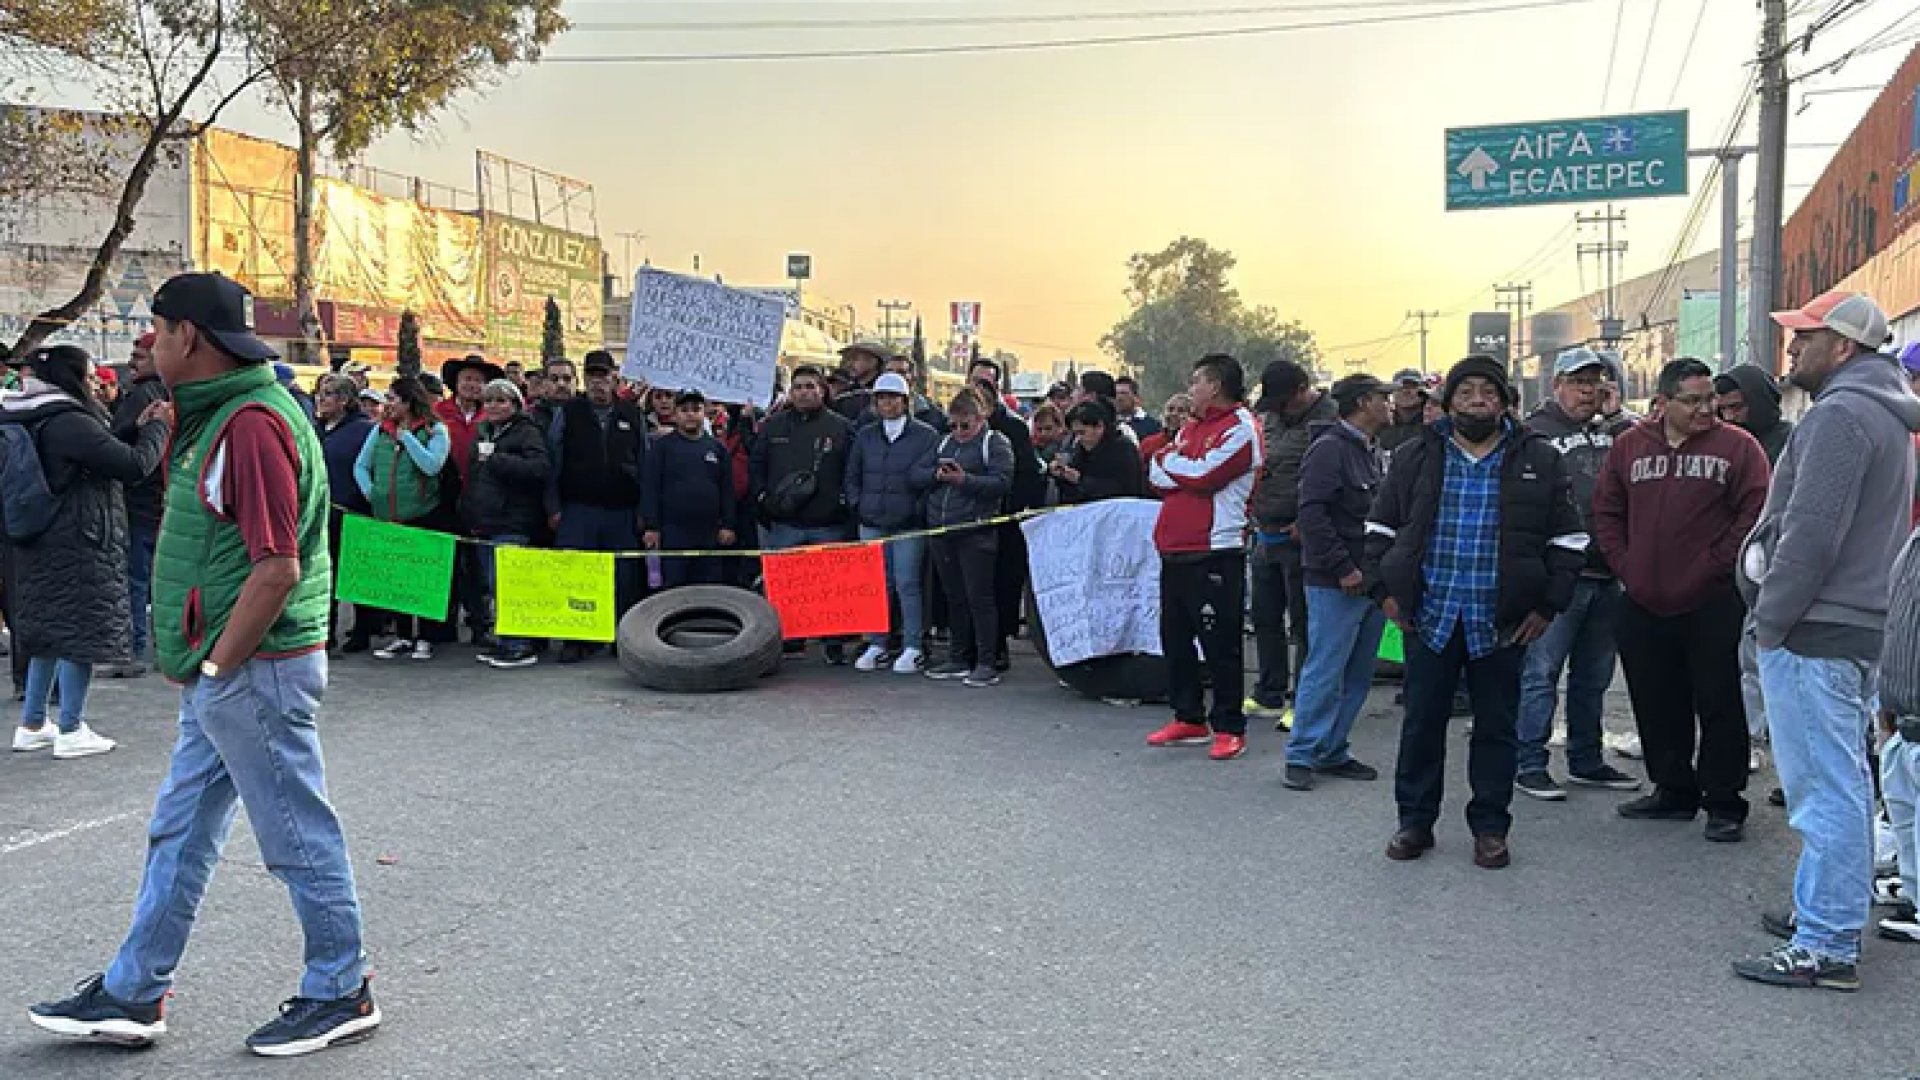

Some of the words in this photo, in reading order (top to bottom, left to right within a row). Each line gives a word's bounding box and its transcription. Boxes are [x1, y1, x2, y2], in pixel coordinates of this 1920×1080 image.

[1510, 129, 1593, 162] AIFA
[1510, 160, 1665, 196] ECATEPEC
[499, 222, 584, 270] GONZALEZ
[1631, 455, 1667, 484] OLD
[1674, 454, 1732, 484] NAVY
